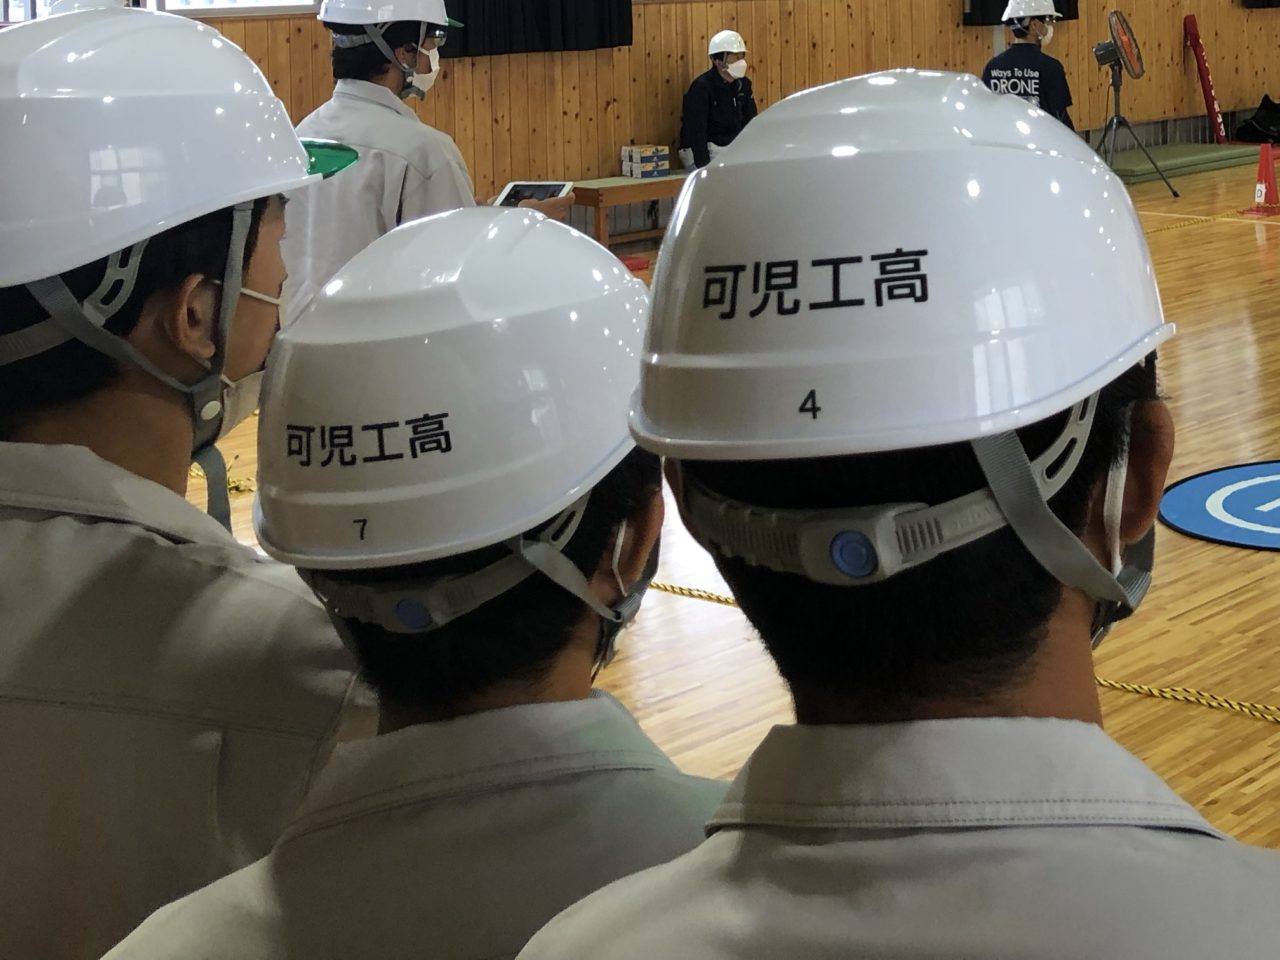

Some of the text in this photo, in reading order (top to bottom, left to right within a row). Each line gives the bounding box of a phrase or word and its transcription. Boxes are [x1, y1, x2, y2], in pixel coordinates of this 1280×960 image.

[990, 68, 1040, 79] Ways To Use
[990, 79, 1040, 95] DRONE
[1256, 189, 1263, 198] D
[703, 248, 929, 320] 可児工高
[798, 389, 822, 420] 4
[286, 412, 452, 467] 可児工高
[352, 518, 368, 540] 7
